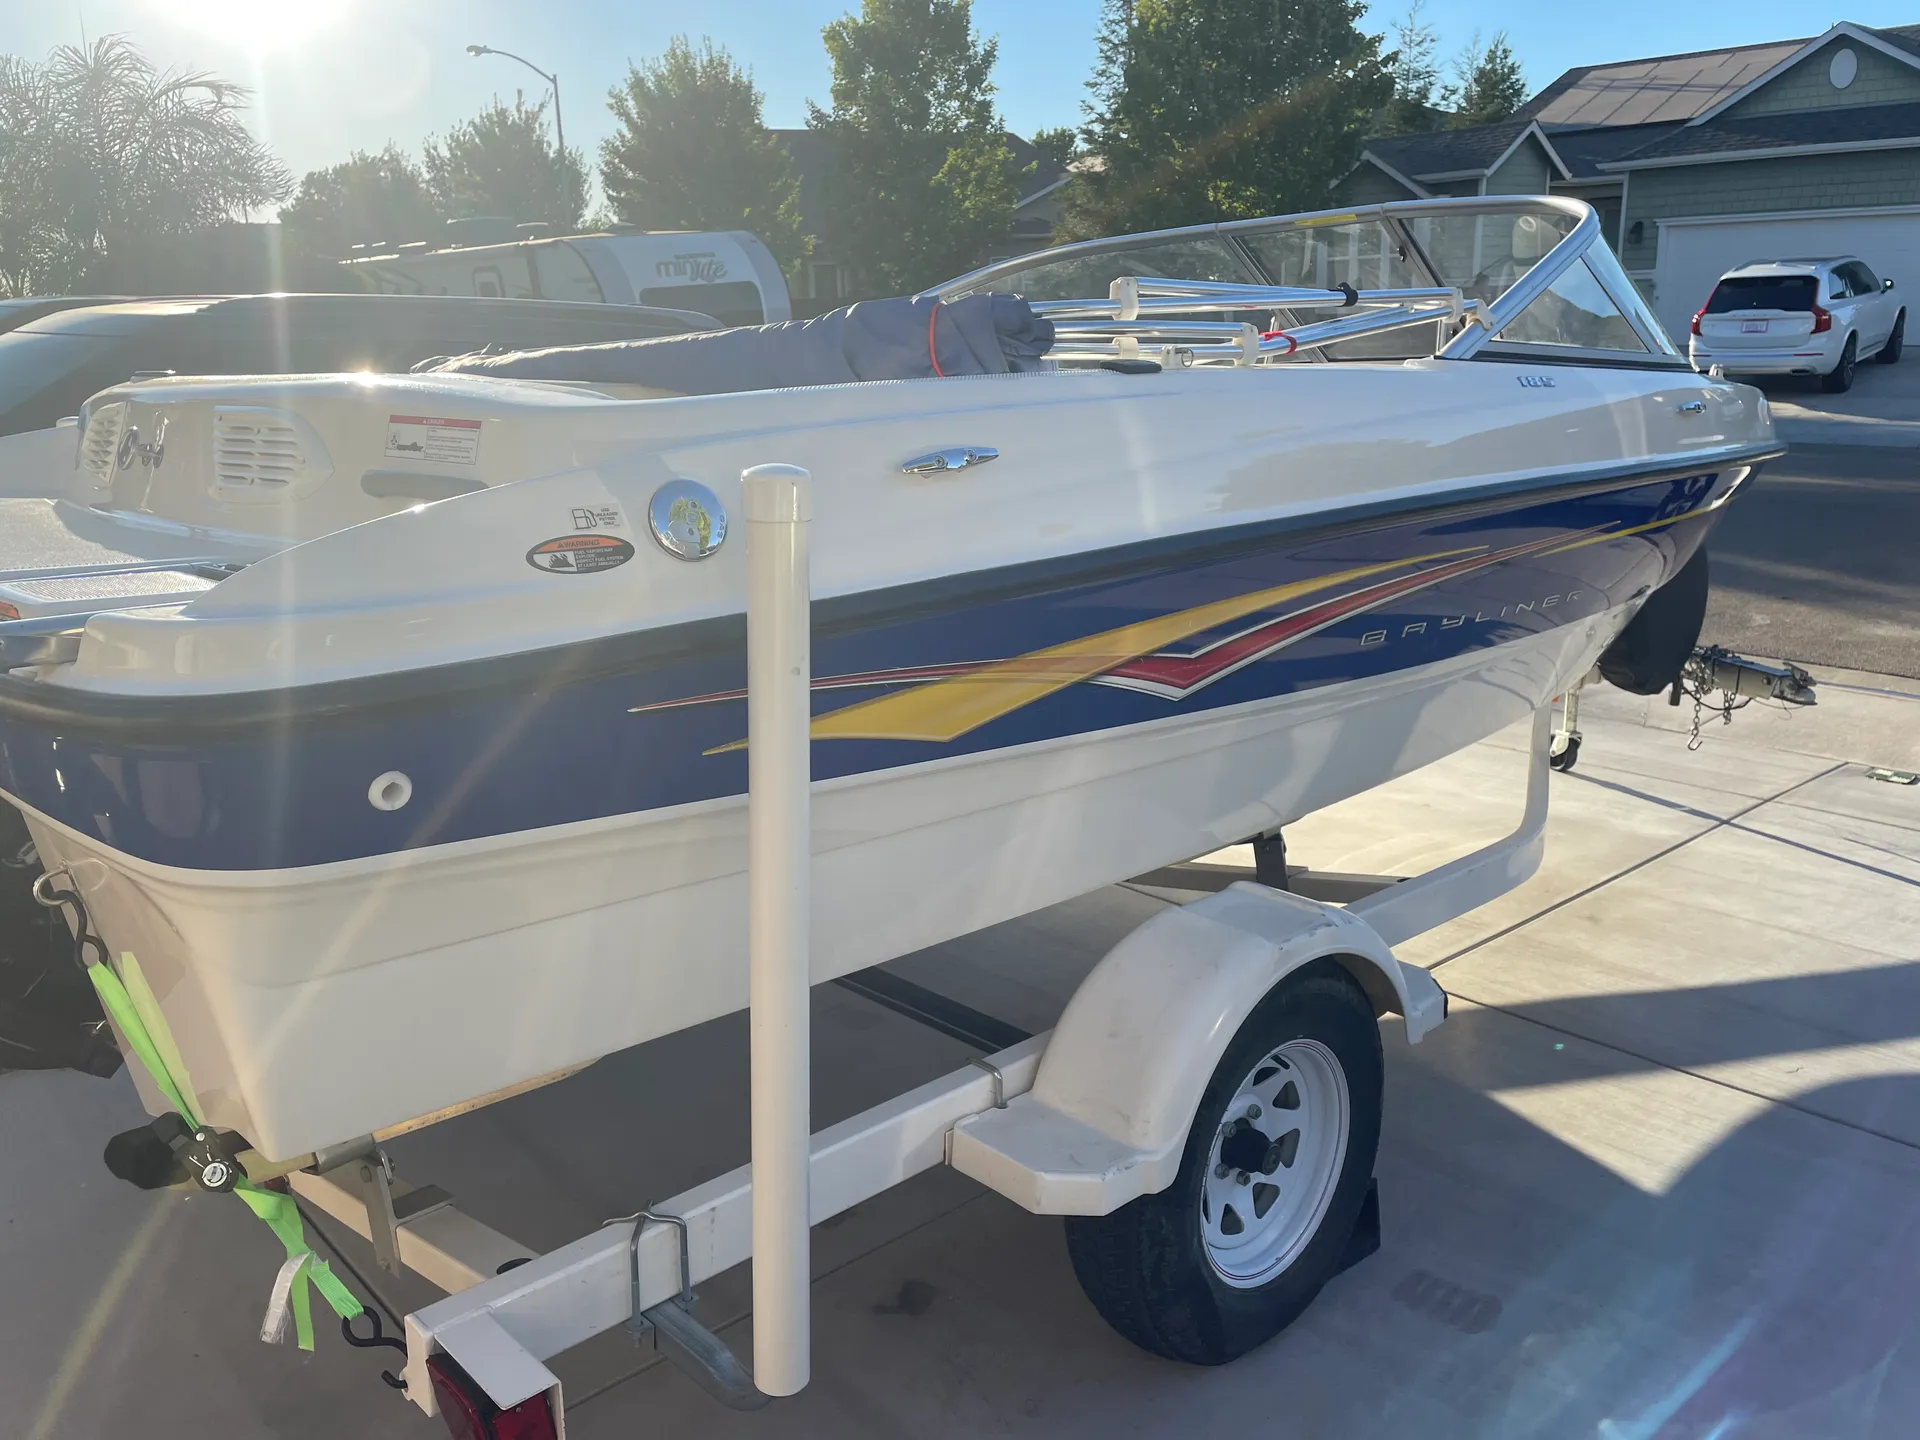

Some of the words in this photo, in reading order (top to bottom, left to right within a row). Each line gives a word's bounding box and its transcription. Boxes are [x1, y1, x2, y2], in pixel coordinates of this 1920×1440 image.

[1516, 375, 1556, 388] 185
[564, 539, 600, 548] WARNING
[1360, 590, 1584, 646] BAYLINER
